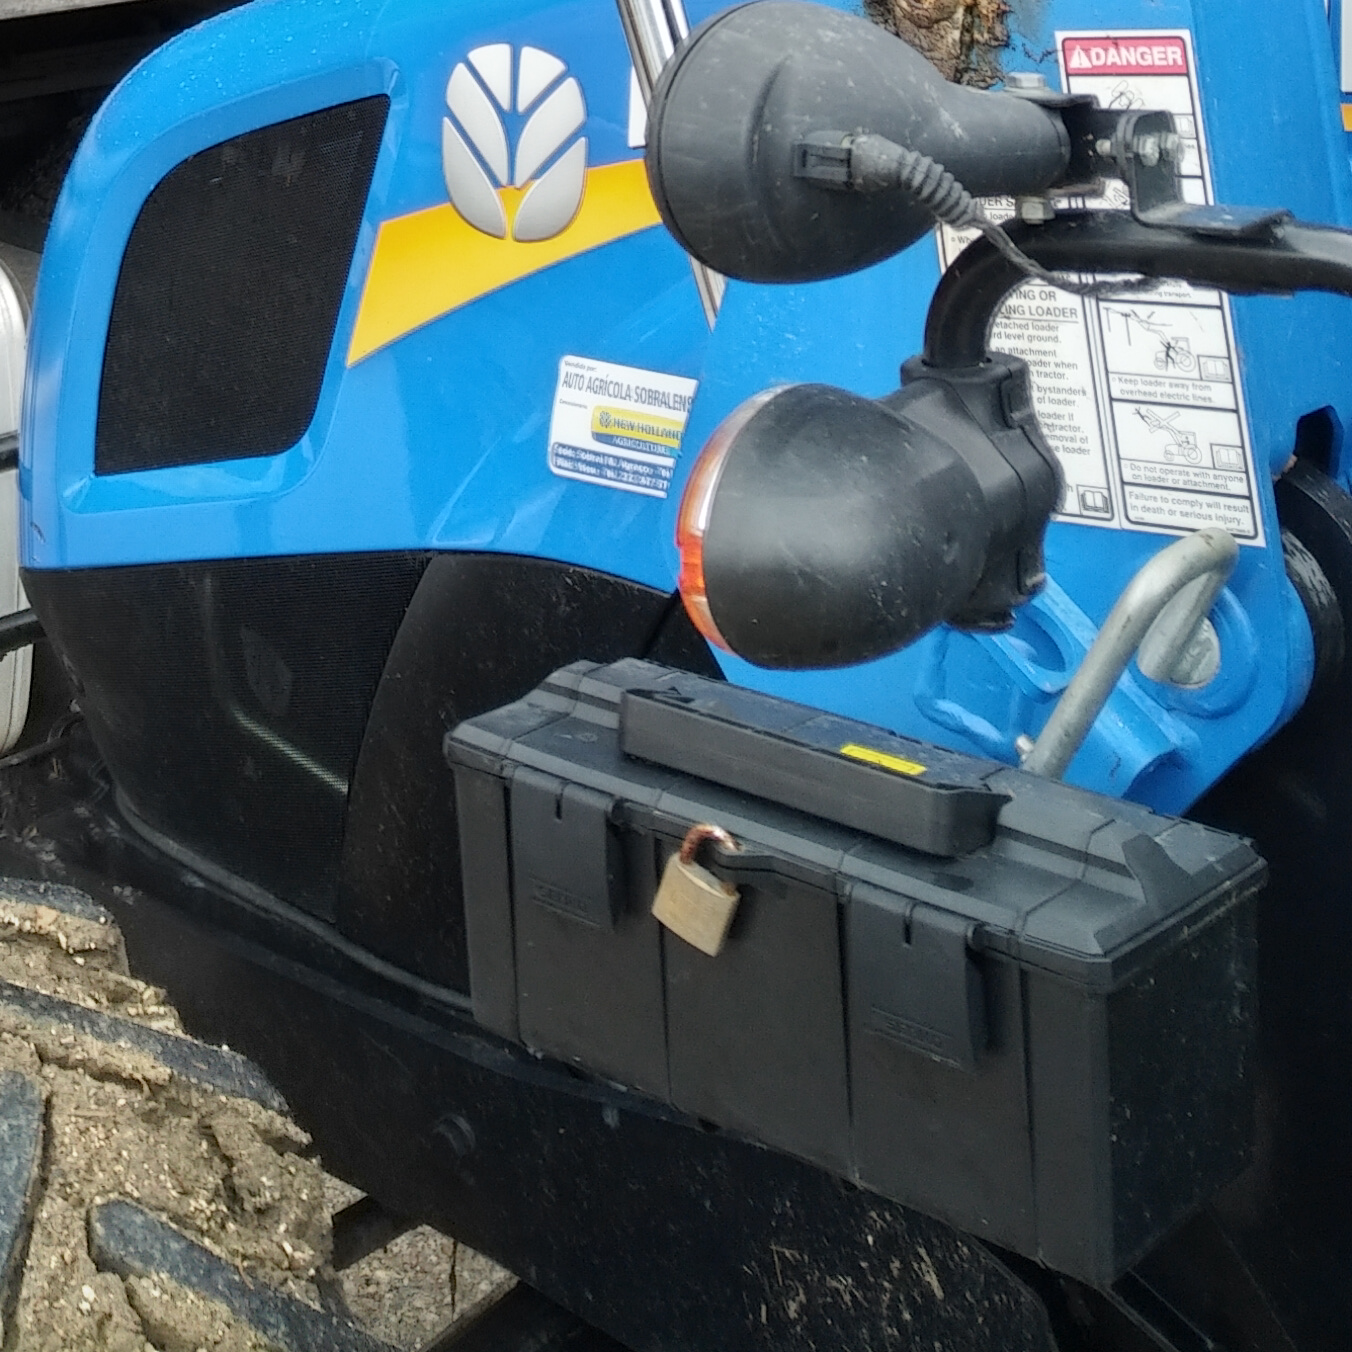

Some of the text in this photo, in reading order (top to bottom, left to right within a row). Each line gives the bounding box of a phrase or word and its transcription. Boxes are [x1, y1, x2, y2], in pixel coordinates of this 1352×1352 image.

[1090, 46, 1183, 66] DANGER
[1039, 290, 1057, 302] OR
[1028, 305, 1079, 319] LOADER
[995, 320, 1059, 332] etached loader
[1004, 331, 1025, 342] level
[1027, 333, 1062, 344] ground.
[1008, 346, 1057, 358] attachment
[1053, 361, 1078, 371] when
[1035, 369, 1069, 381] tractor.
[562, 371, 584, 391] AUTO
[586, 371, 633, 401] AGRÍCOLA
[1118, 375, 1212, 392] Keep loader away from
[1036, 385, 1086, 397] bystanders
[1120, 387, 1157, 399] overhead
[1159, 390, 1190, 401] electric
[1036, 395, 1046, 404] of
[1037, 410, 1066, 421] loader
[1079, 436, 1088, 444] of
[1062, 445, 1091, 456] loader
[1129, 463, 1244, 484] Do not operate with anyone
[1143, 473, 1169, 484] loader
[1171, 477, 1181, 485] or
[1182, 478, 1231, 491] attachment.
[1129, 490, 1250, 514] Failure to comply will result
[1130, 503, 1245, 526] in death or serious injury.
